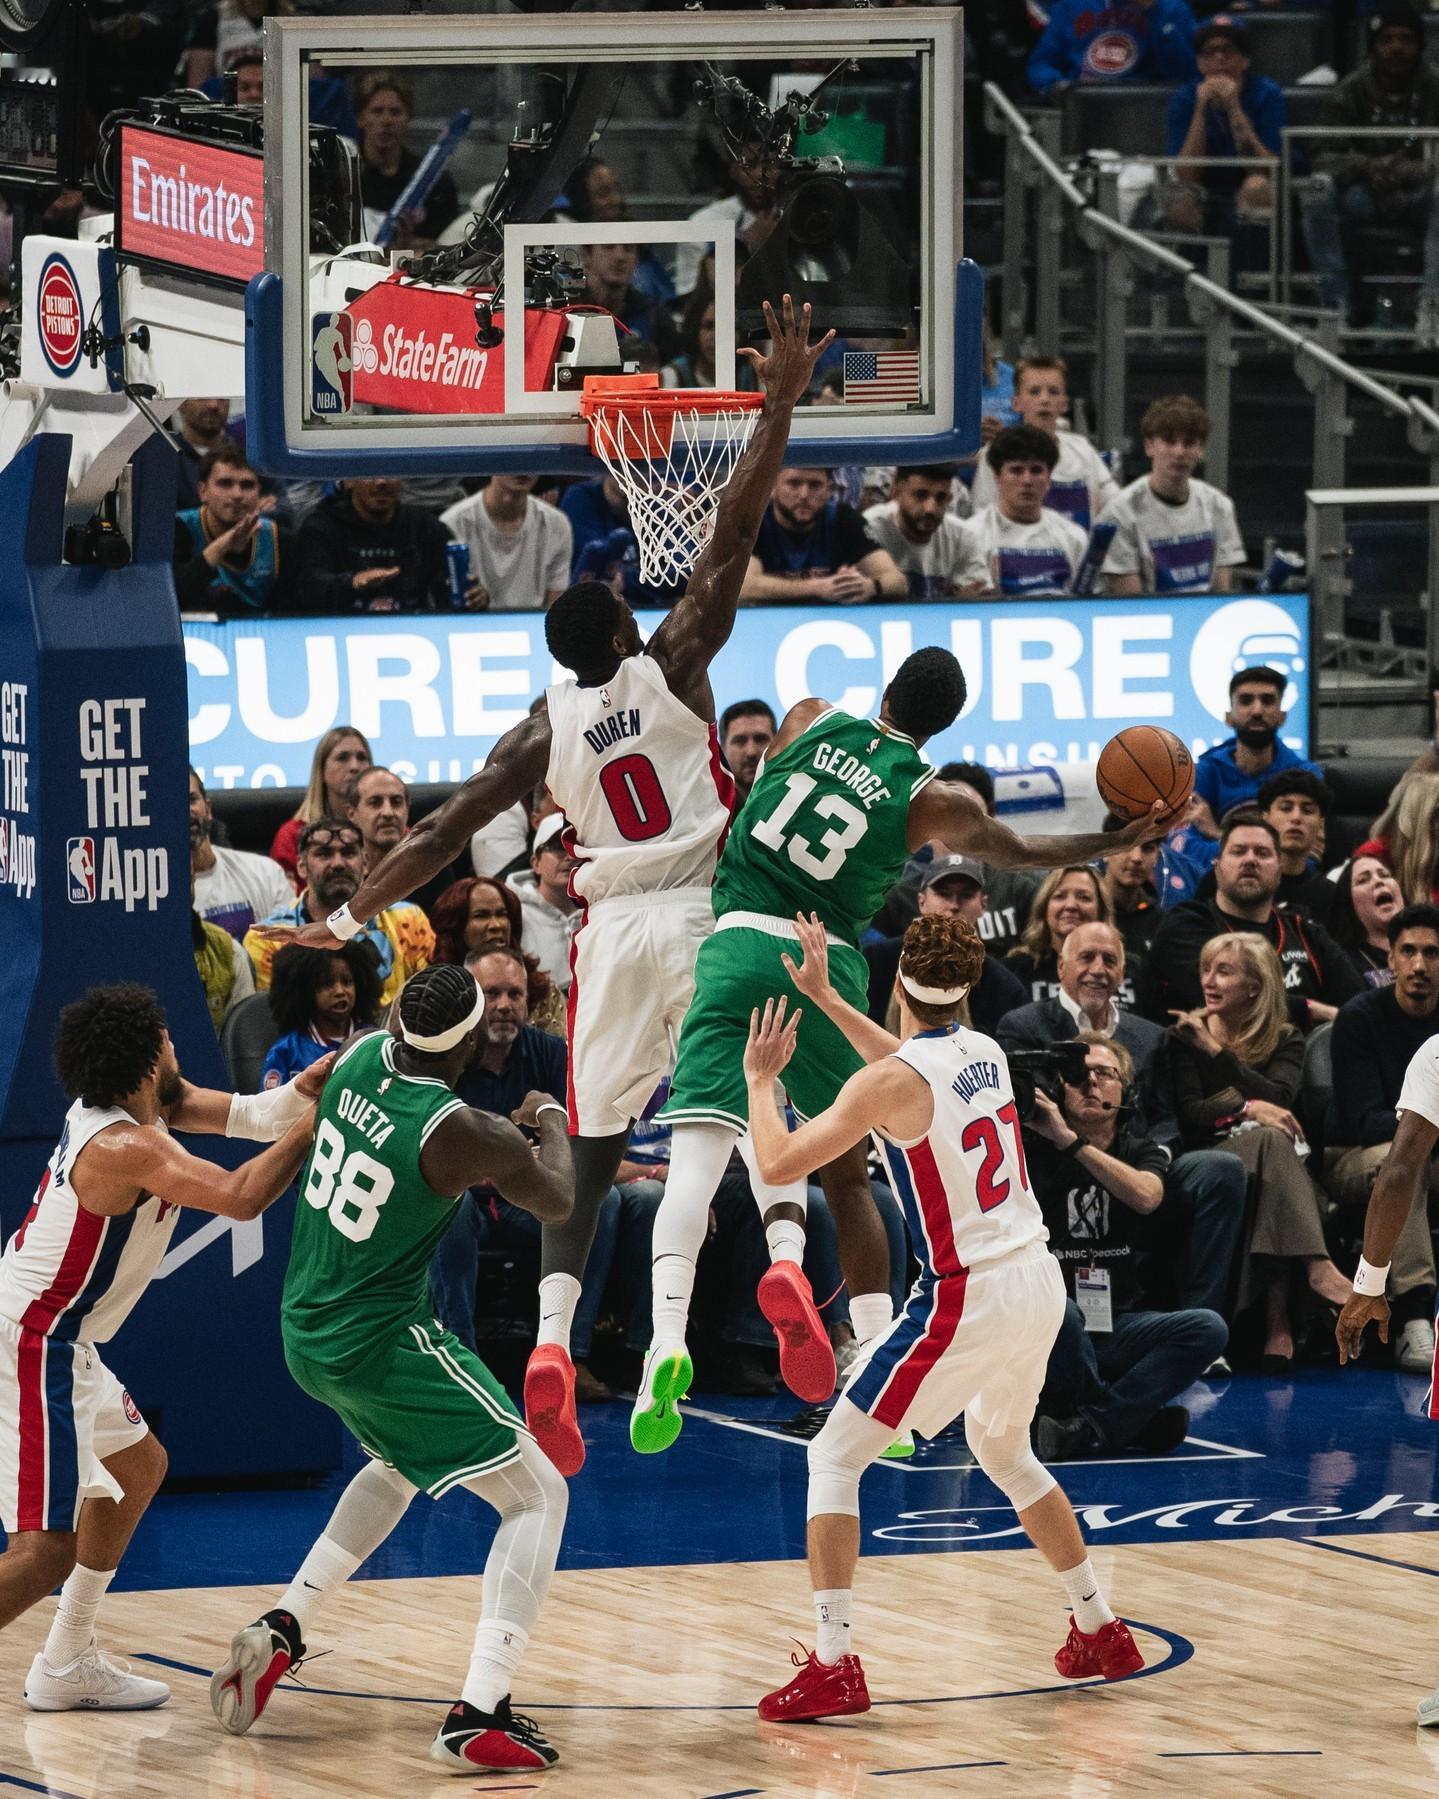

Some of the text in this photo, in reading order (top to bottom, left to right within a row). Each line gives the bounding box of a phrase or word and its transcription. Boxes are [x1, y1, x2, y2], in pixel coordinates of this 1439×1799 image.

[131, 156, 255, 248] Emirates
[45, 294, 73, 316] DETROIT
[46, 315, 76, 336] PISTONS
[316, 392, 337, 409] NBA
[774, 614, 1175, 722] CURE
[2, 681, 28, 746] GET
[79, 698, 146, 762] GET
[583, 708, 641, 755] DUREN
[2, 749, 29, 814] THE
[80, 765, 151, 829] THE
[599, 753, 672, 842] 0
[812, 742, 892, 811] GEORGE
[750, 772, 869, 881] 13
[8, 820, 36, 899] App
[101, 836, 169, 913] App
[72, 888, 86, 900] NBA
[1281, 951, 1308, 962] UWM
[951, 1061, 1001, 1105] HUERTER
[337, 1088, 396, 1150] QUETA
[304, 1117, 395, 1243] 88
[1065, 1250, 1087, 1259] NBC
